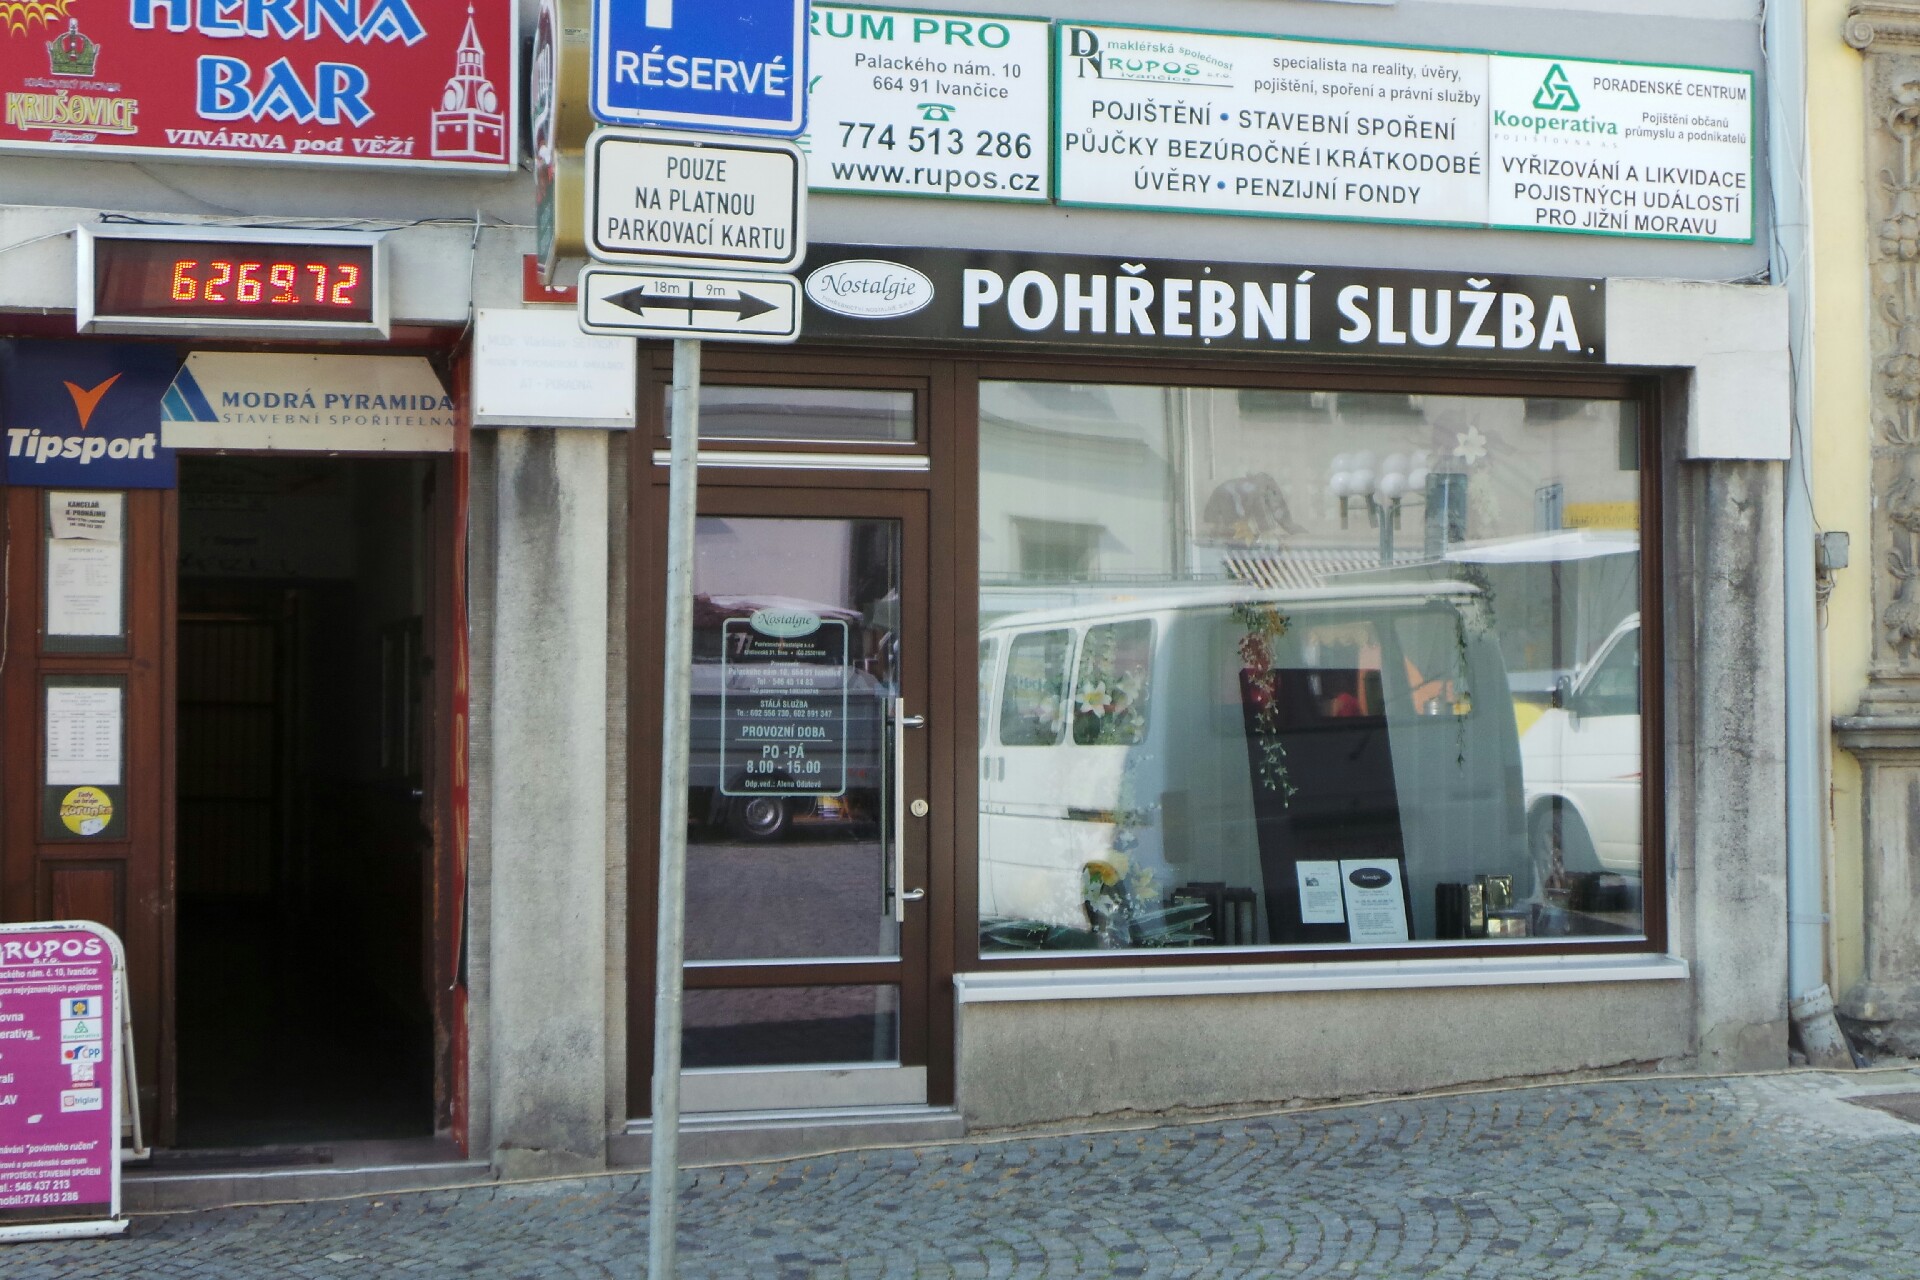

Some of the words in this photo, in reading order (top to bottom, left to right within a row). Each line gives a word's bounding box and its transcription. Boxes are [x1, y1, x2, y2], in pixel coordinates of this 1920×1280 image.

[912, 17, 1011, 49] PRO
[855, 52, 947, 73] Palackého
[953, 60, 996, 77] nám.
[1002, 63, 1022, 78] 10
[1107, 40, 1174, 54] makléřská
[1179, 46, 1234, 71] společnost
[1107, 57, 1200, 76] RUPOS
[615, 45, 786, 97] RÉSERVÉ
[1273, 56, 1347, 72] specialista
[1351, 62, 1368, 74] na
[1372, 63, 1417, 79] reality,
[1421, 65, 1462, 82] úvěry,
[197, 54, 376, 128] BAR
[873, 75, 904, 92] 664
[909, 78, 929, 94] 91
[936, 79, 1009, 99] Ivančice
[1254, 78, 1318, 97] pojištění,
[1322, 82, 1374, 100] spoření
[1378, 88, 1386, 98] a
[1390, 87, 1433, 102] právní
[1437, 90, 1481, 106] služby
[1593, 76, 1683, 96] PORADENSKÉ
[1686, 83, 1747, 101] CENTRUM
[6, 89, 138, 134] KRUŠOVICE
[1092, 98, 1212, 126] POJIŠTĚNÍ
[1239, 110, 1350, 135] STAVEBNÍ
[1357, 115, 1456, 141] SPOŘENÍ
[1494, 109, 1618, 135] Kooperativa
[1642, 112, 1688, 126] Pojištění
[1691, 115, 1730, 129] občanů
[165, 127, 286, 151] VINÁRNA
[292, 137, 343, 155] pod
[353, 134, 417, 157] VĚŽÍ
[839, 121, 896, 151] 774
[908, 126, 964, 156] 513
[975, 129, 1032, 159] 286
[1625, 126, 1676, 141] průmyslu
[1678, 131, 1685, 140] a
[1687, 130, 1747, 145] podnikatelů
[1066, 127, 1159, 156] PŮJČKY
[1168, 137, 1310, 165] BEZÚROČNÉ
[1316, 149, 1321, 166] I
[1327, 147, 1481, 175] KRÁTKODOBÉ
[666, 156, 727, 183] POUZE
[831, 162, 1041, 193] www.rupos.cz
[1502, 154, 1620, 181] VYŘIZOVÁNÍ
[1625, 165, 1639, 182] A
[1645, 166, 1747, 189] LIKVIDACE
[1134, 165, 1212, 193] ÚVĚRY
[1235, 176, 1338, 201] PENZIJNÍ
[1345, 182, 1421, 205] FONDY
[1514, 182, 1637, 207] POJISTNÝCH
[1643, 190, 1740, 213] UDÁLOSTÍ
[635, 186, 661, 211] NA
[668, 189, 755, 217] PLATNOU
[608, 217, 714, 246] PARKOVACÍ
[721, 224, 786, 250] KARTU
[1536, 207, 1577, 226] PRO
[1583, 209, 1629, 230] JIŽNÍ
[1634, 214, 1718, 236] MORAVU
[653, 281, 680, 294] 18m
[706, 284, 726, 297] 9m
[821, 273, 917, 300] Nostalgie
[963, 262, 1317, 342] POHŘEBNÍ
[1337, 276, 1582, 351] SLUŽBA
[222, 387, 316, 409] MODRÁ
[324, 392, 454, 411] PYRAMIDA
[222, 411, 320, 425] STAVEBNÍ
[329, 413, 457, 427] SPOŘITELNA
[7, 427, 156, 465] Tipsport
[758, 613, 812, 629] Nostalgie
[760, 699, 781, 708] STÁLÁ
[782, 699, 808, 709] SLUŽBA
[742, 724, 795, 738] PROVOZNÍ
[797, 726, 826, 738] DOBA
[762, 745, 780, 759] PO
[747, 760, 774, 774] 8.00
[786, 761, 821, 774] 15.00
[60, 805, 113, 817] Korunka
[4, 938, 103, 960] RUPOS
[74, 1096, 99, 1106] triglav
[15, 1181, 32, 1192] 546
[34, 1180, 51, 1191] 437
[52, 1179, 70, 1190] 213
[42, 1193, 60, 1203] 513
[61, 1191, 79, 1202] 286
